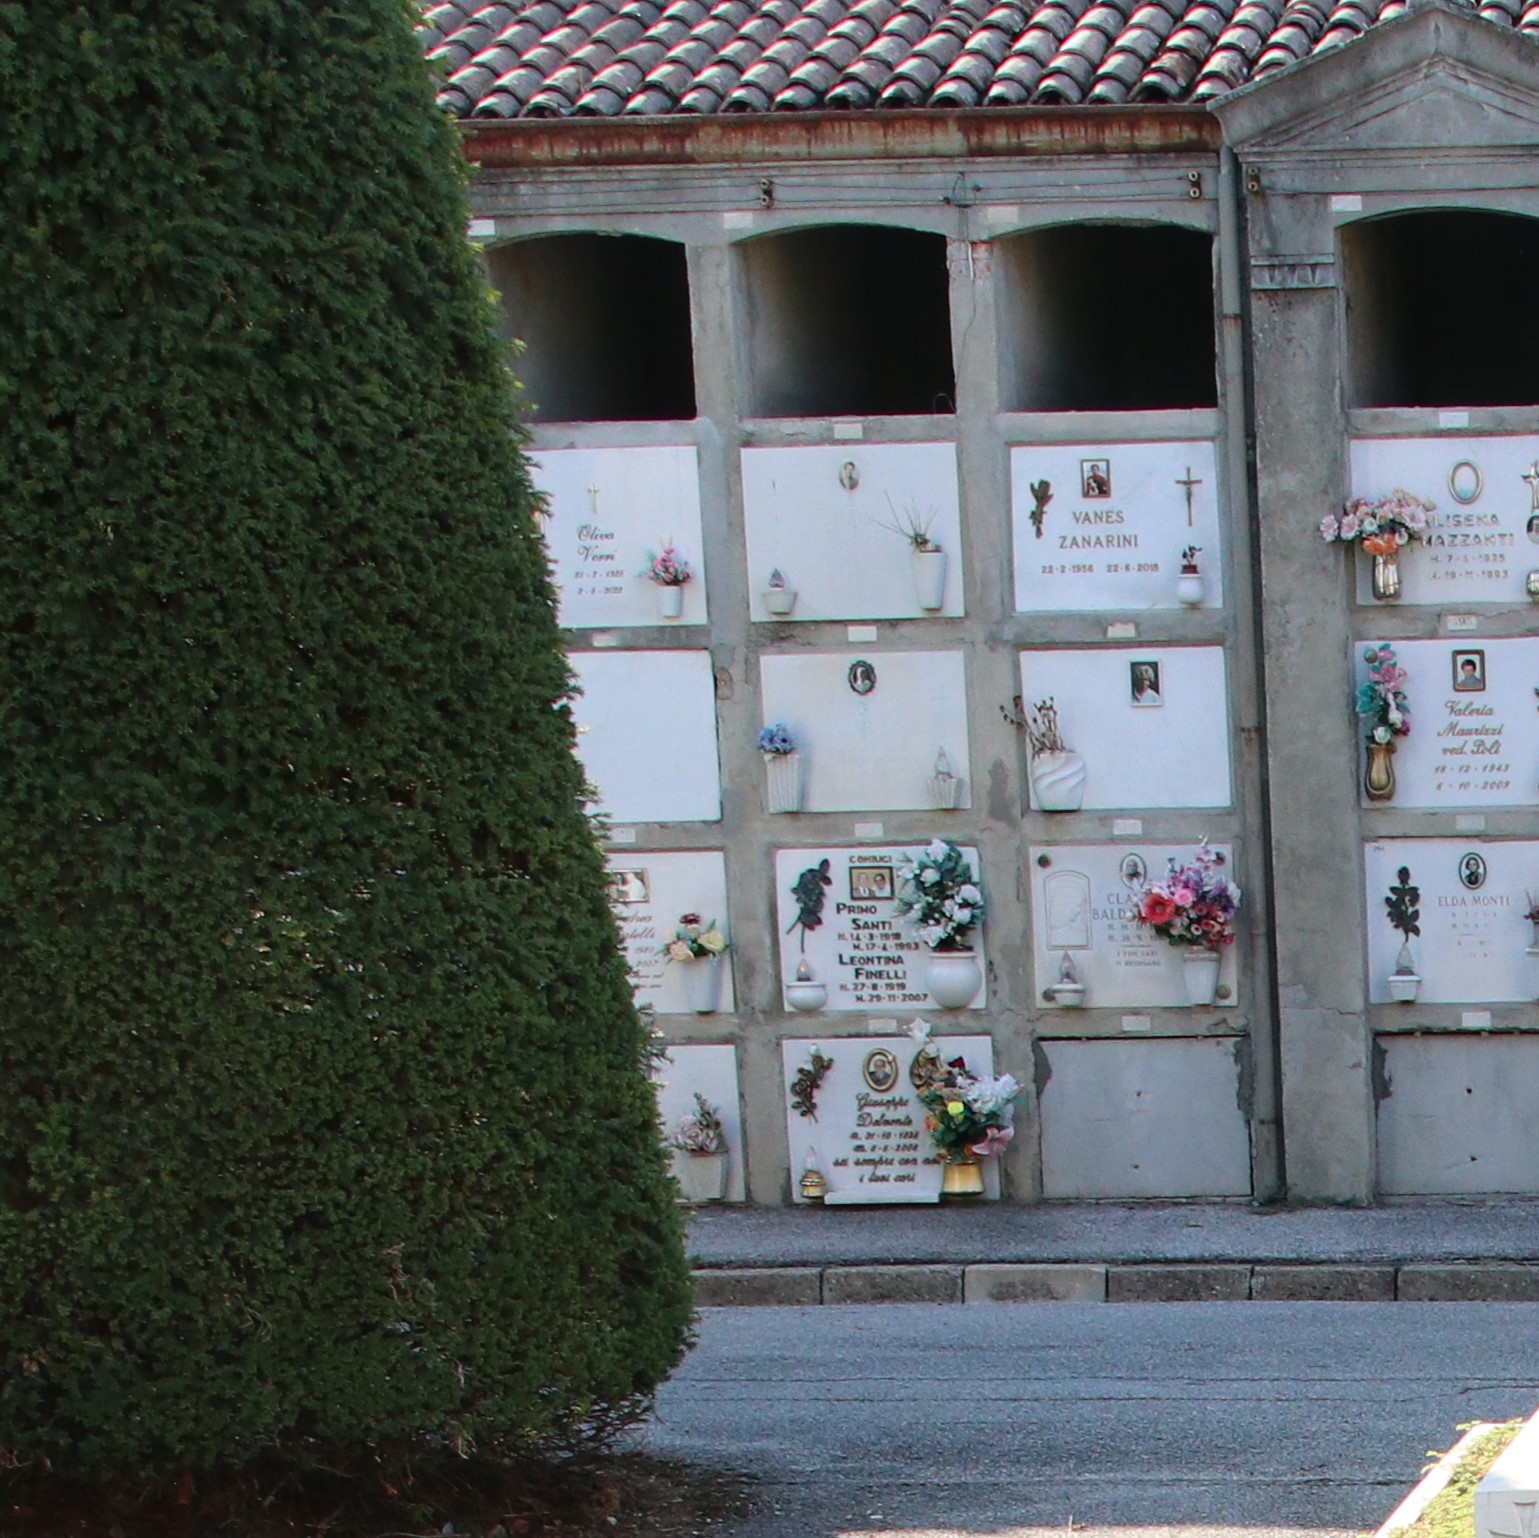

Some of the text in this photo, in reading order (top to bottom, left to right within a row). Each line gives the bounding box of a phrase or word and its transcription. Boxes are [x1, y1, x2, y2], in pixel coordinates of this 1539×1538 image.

[1072, 510, 1125, 524] VANES
[576, 523, 616, 541] Oliva
[1059, 534, 1139, 549] ZANARINI
[1444, 700, 1495, 716] Valeria
[1438, 895, 1510, 907] ELDA MONTI
[851, 918, 893, 931] SANTI
[838, 953, 905, 966] LEONTINA
[854, 968, 907, 980] FINELLI
